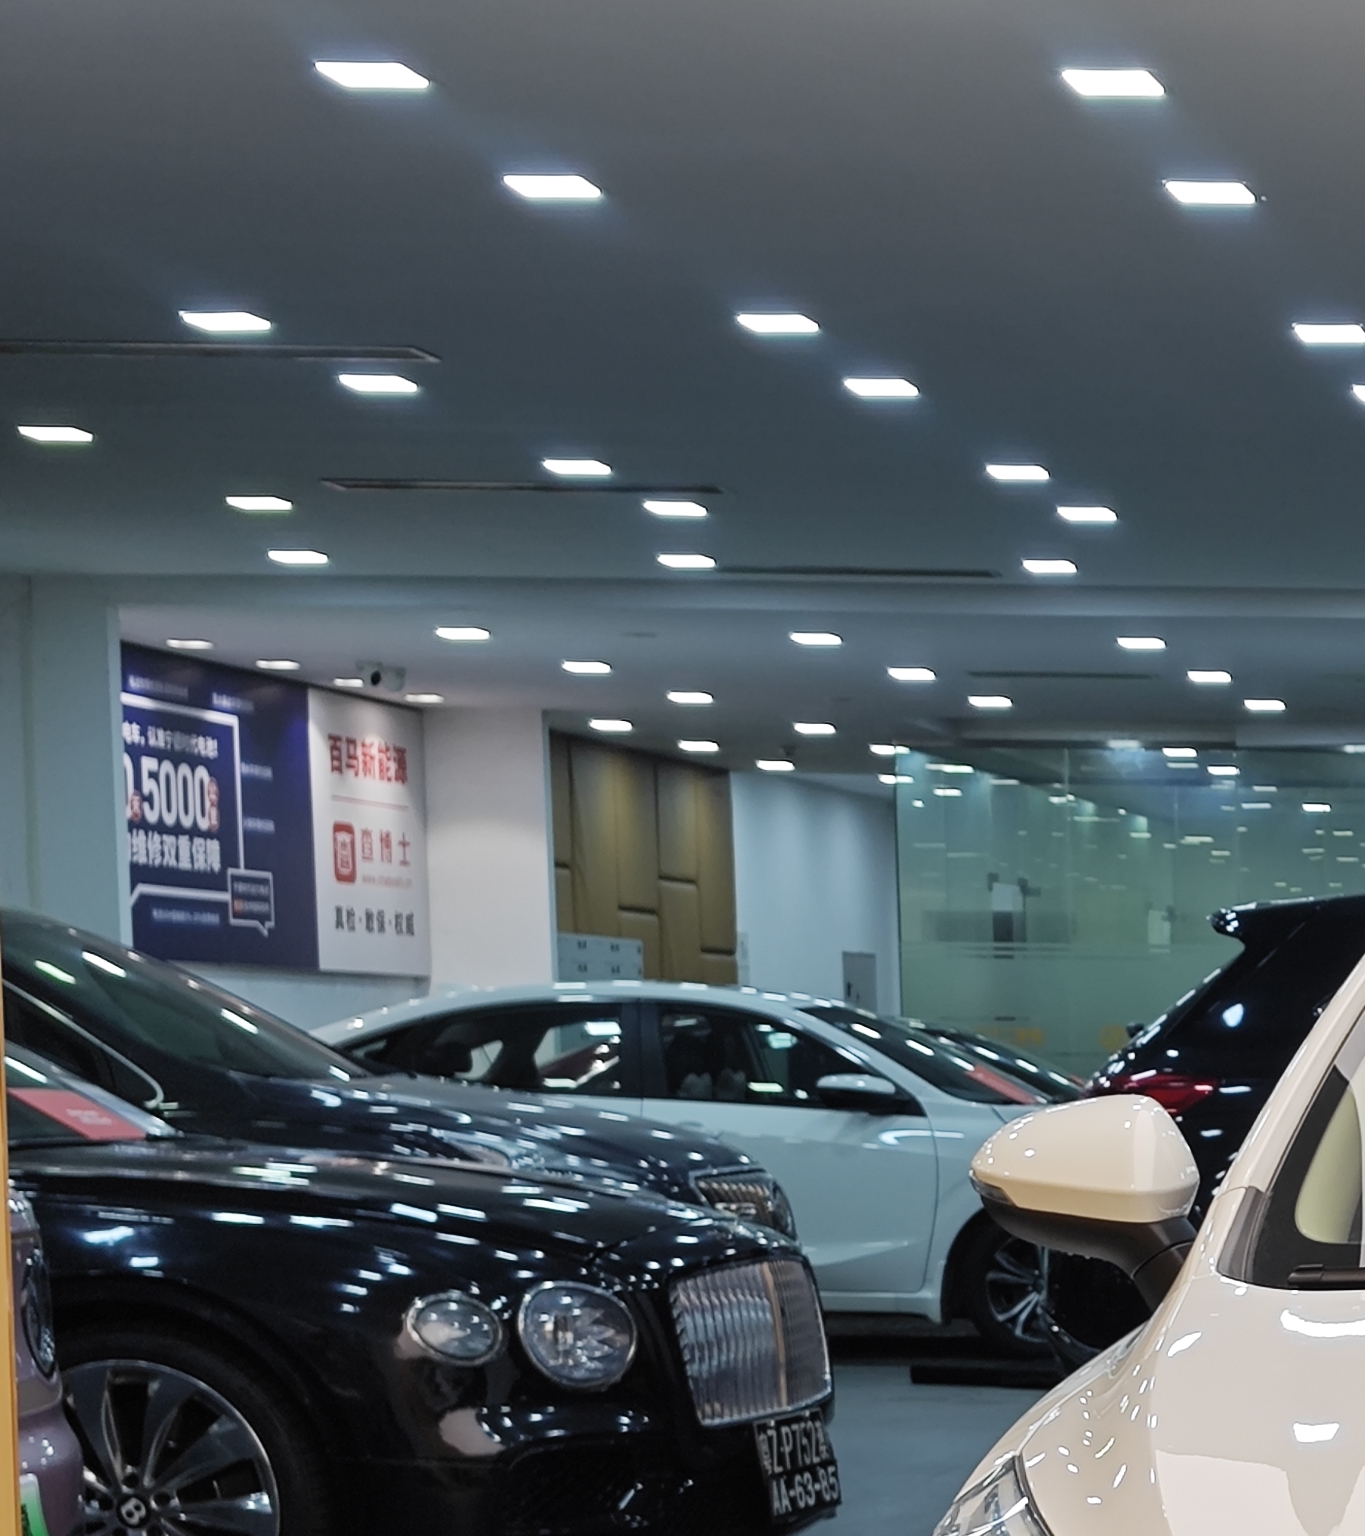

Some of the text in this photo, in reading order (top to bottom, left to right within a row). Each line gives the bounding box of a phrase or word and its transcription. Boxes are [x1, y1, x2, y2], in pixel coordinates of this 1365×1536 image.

[328, 733, 408, 785] 百马新能源
